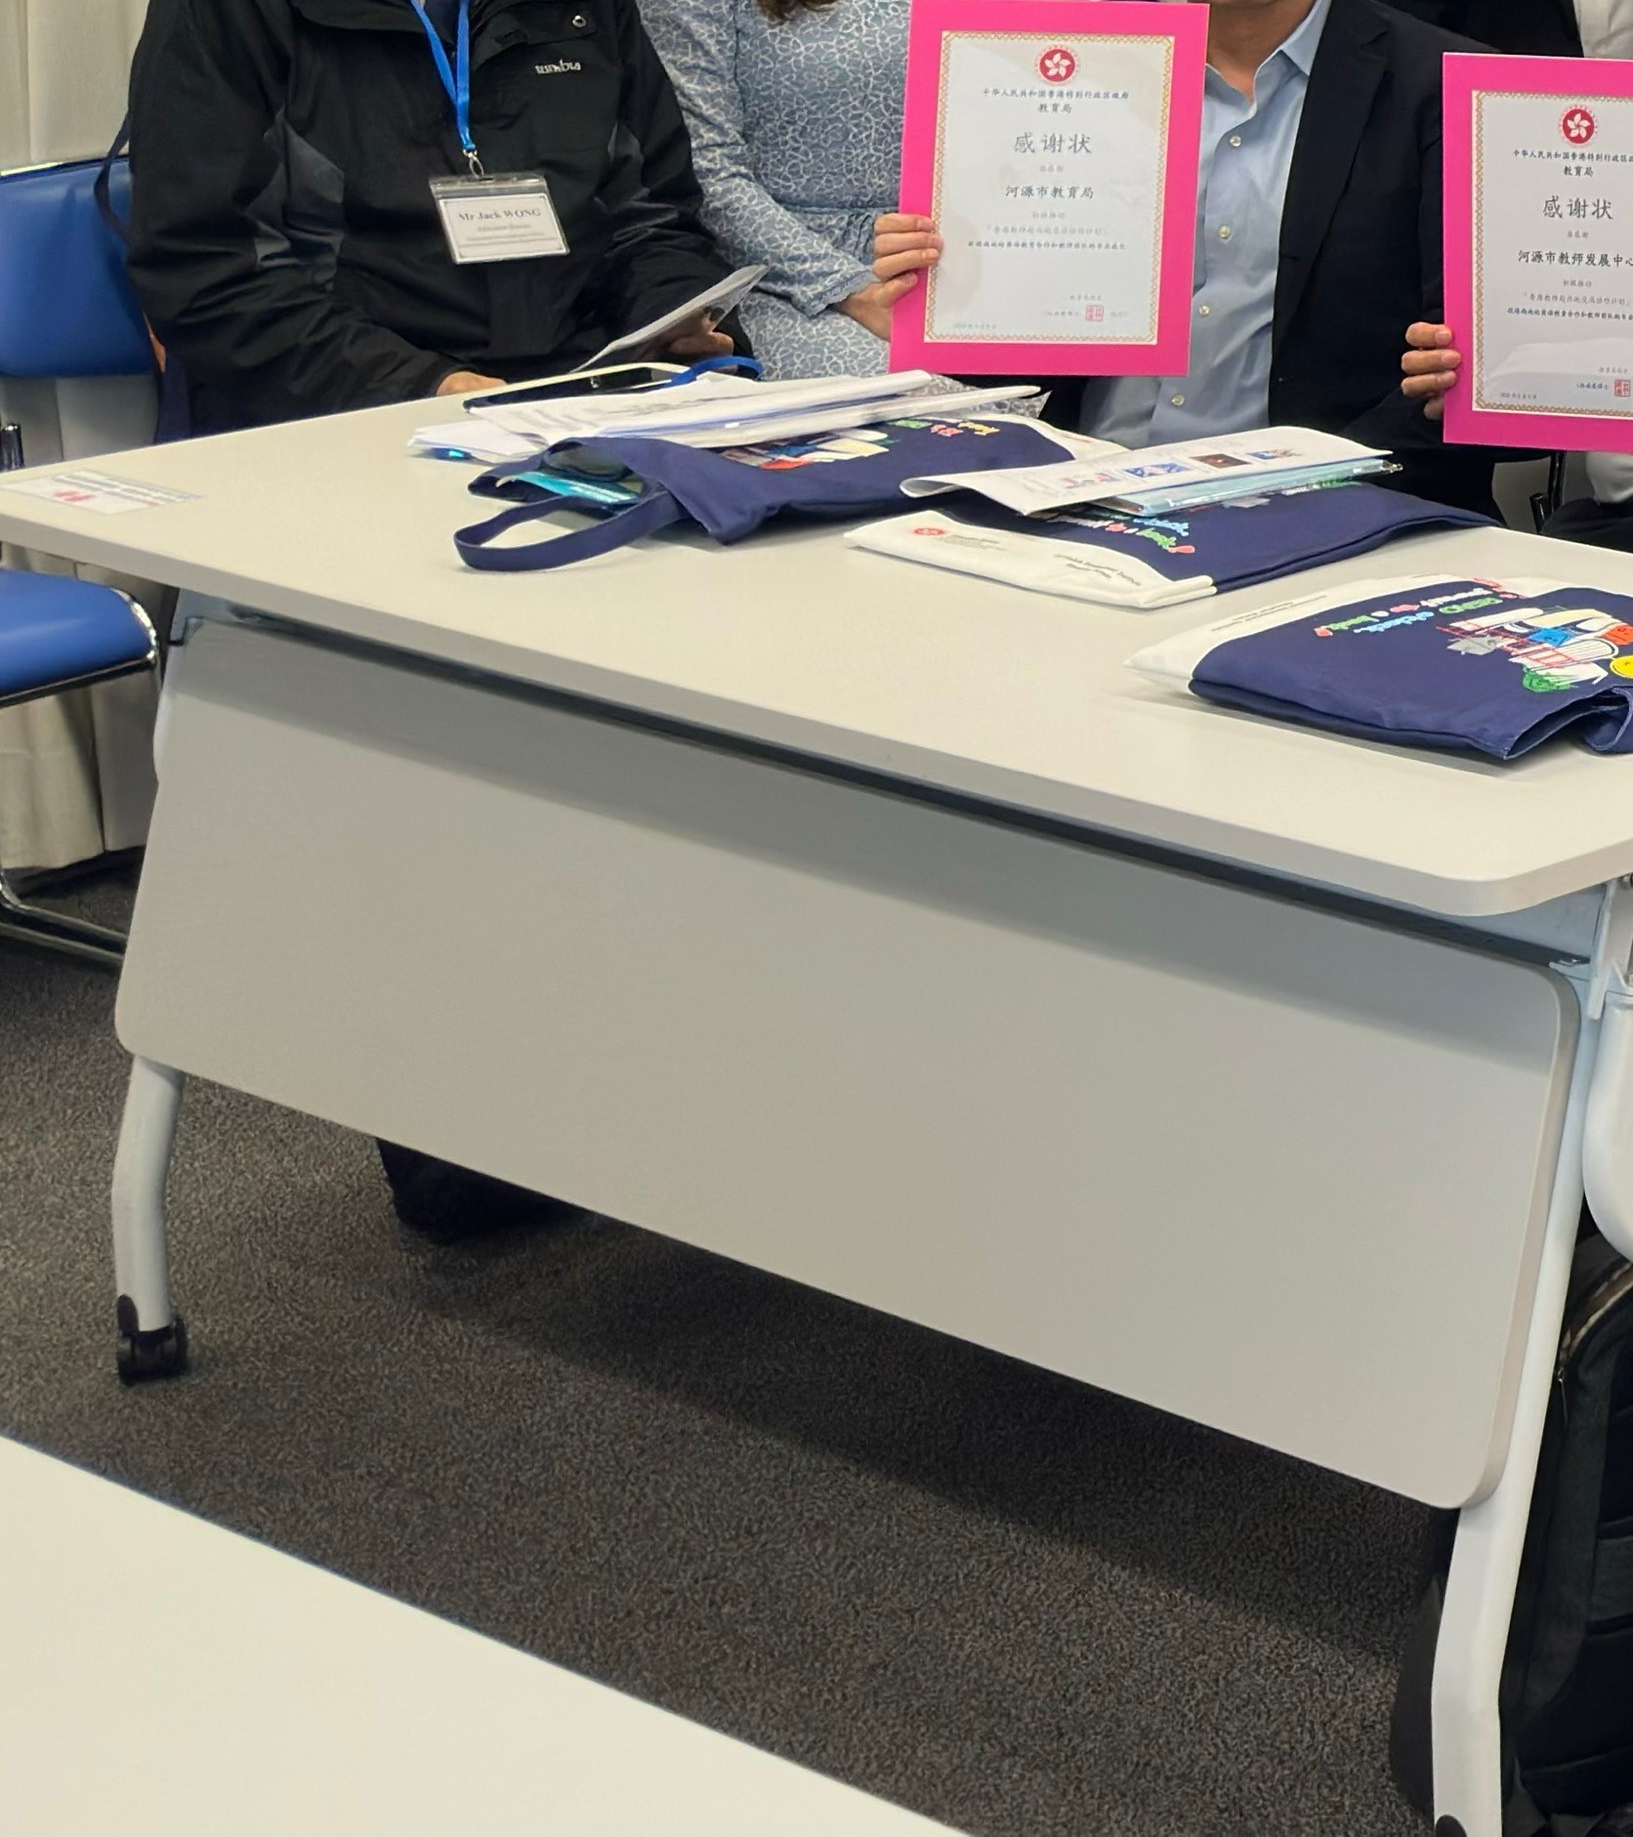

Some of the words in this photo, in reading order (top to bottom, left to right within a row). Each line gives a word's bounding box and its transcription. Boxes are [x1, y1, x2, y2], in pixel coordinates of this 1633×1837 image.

[1038, 103, 1073, 114] 教育局
[1013, 131, 1093, 154] 感谢状
[1563, 166, 1594, 177] 教育局
[1005, 185, 1095, 200] 河源市教育局
[1543, 195, 1613, 219] 感谢状
[458, 212, 475, 221] Mr
[477, 210, 501, 221] Jack
[503, 208, 541, 218] WONG
